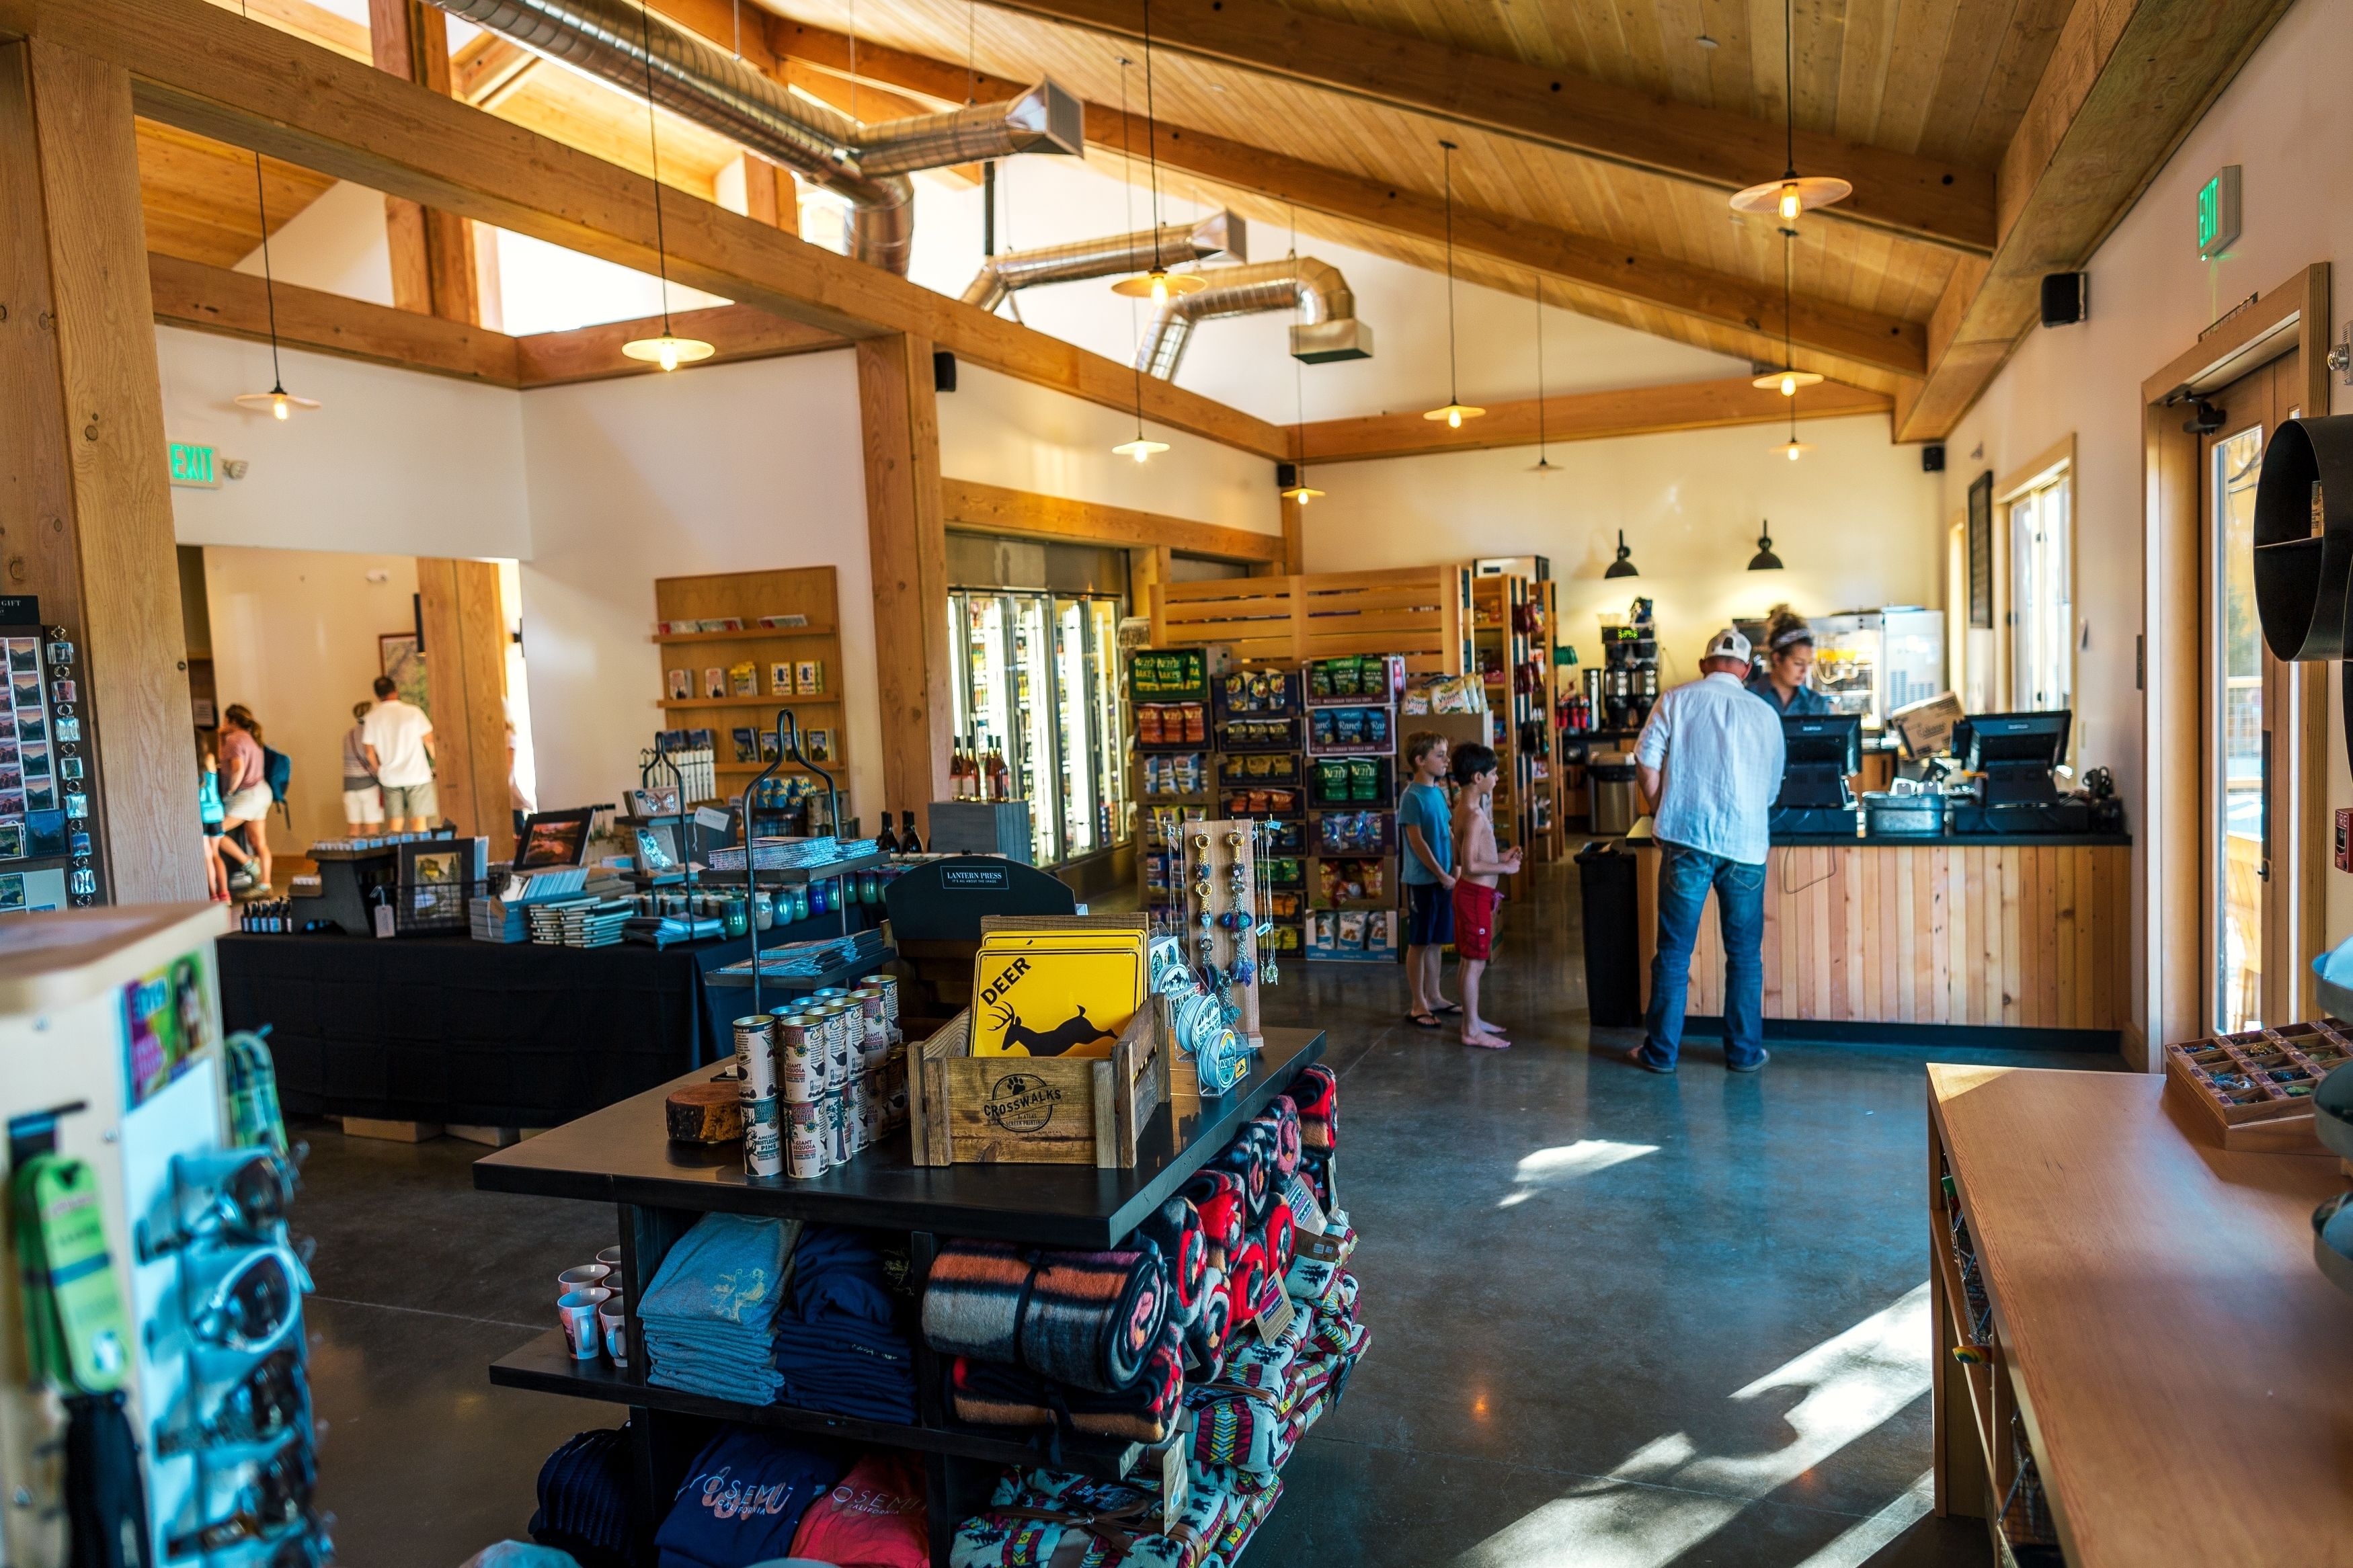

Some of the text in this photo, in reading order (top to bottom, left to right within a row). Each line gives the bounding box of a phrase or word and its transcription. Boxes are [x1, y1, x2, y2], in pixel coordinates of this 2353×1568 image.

[2199, 176, 2218, 249] EXIT
[170, 444, 212, 483] EXIT
[2336, 812, 2347, 827] FIRE
[980, 957, 1031, 1006] DEER
[793, 1106, 812, 1114] GROW
[984, 1089, 1062, 1117] CROSSWALKS
[717, 1498, 764, 1516] CALIFORNIA
[847, 1503, 900, 1516] CALIFORNIA
